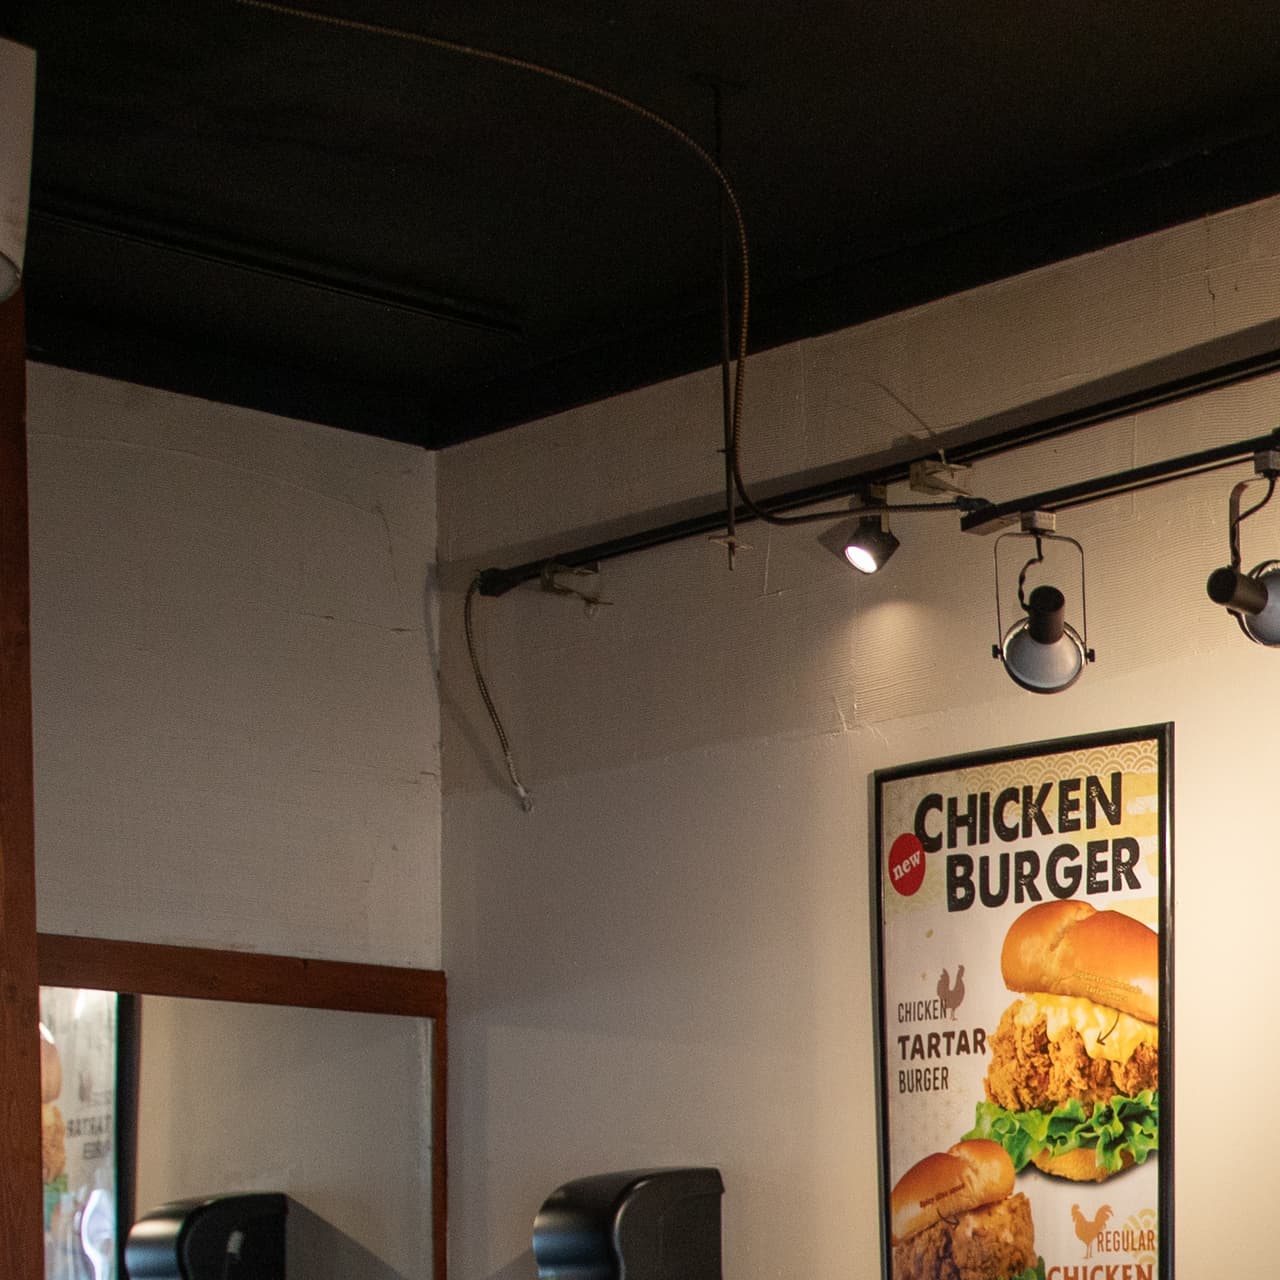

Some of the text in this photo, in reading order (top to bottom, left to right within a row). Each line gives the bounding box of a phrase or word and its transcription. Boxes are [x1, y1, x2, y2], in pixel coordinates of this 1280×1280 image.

[914, 771, 1122, 853] CHICKEN
[892, 849, 921, 880] new
[947, 836, 1142, 912] BURGER
[898, 1000, 947, 1023] CHICKEN
[898, 1028, 986, 1060] TARTAR
[898, 1066, 949, 1094] BURGER
[1097, 1230, 1155, 1252] REGULAR
